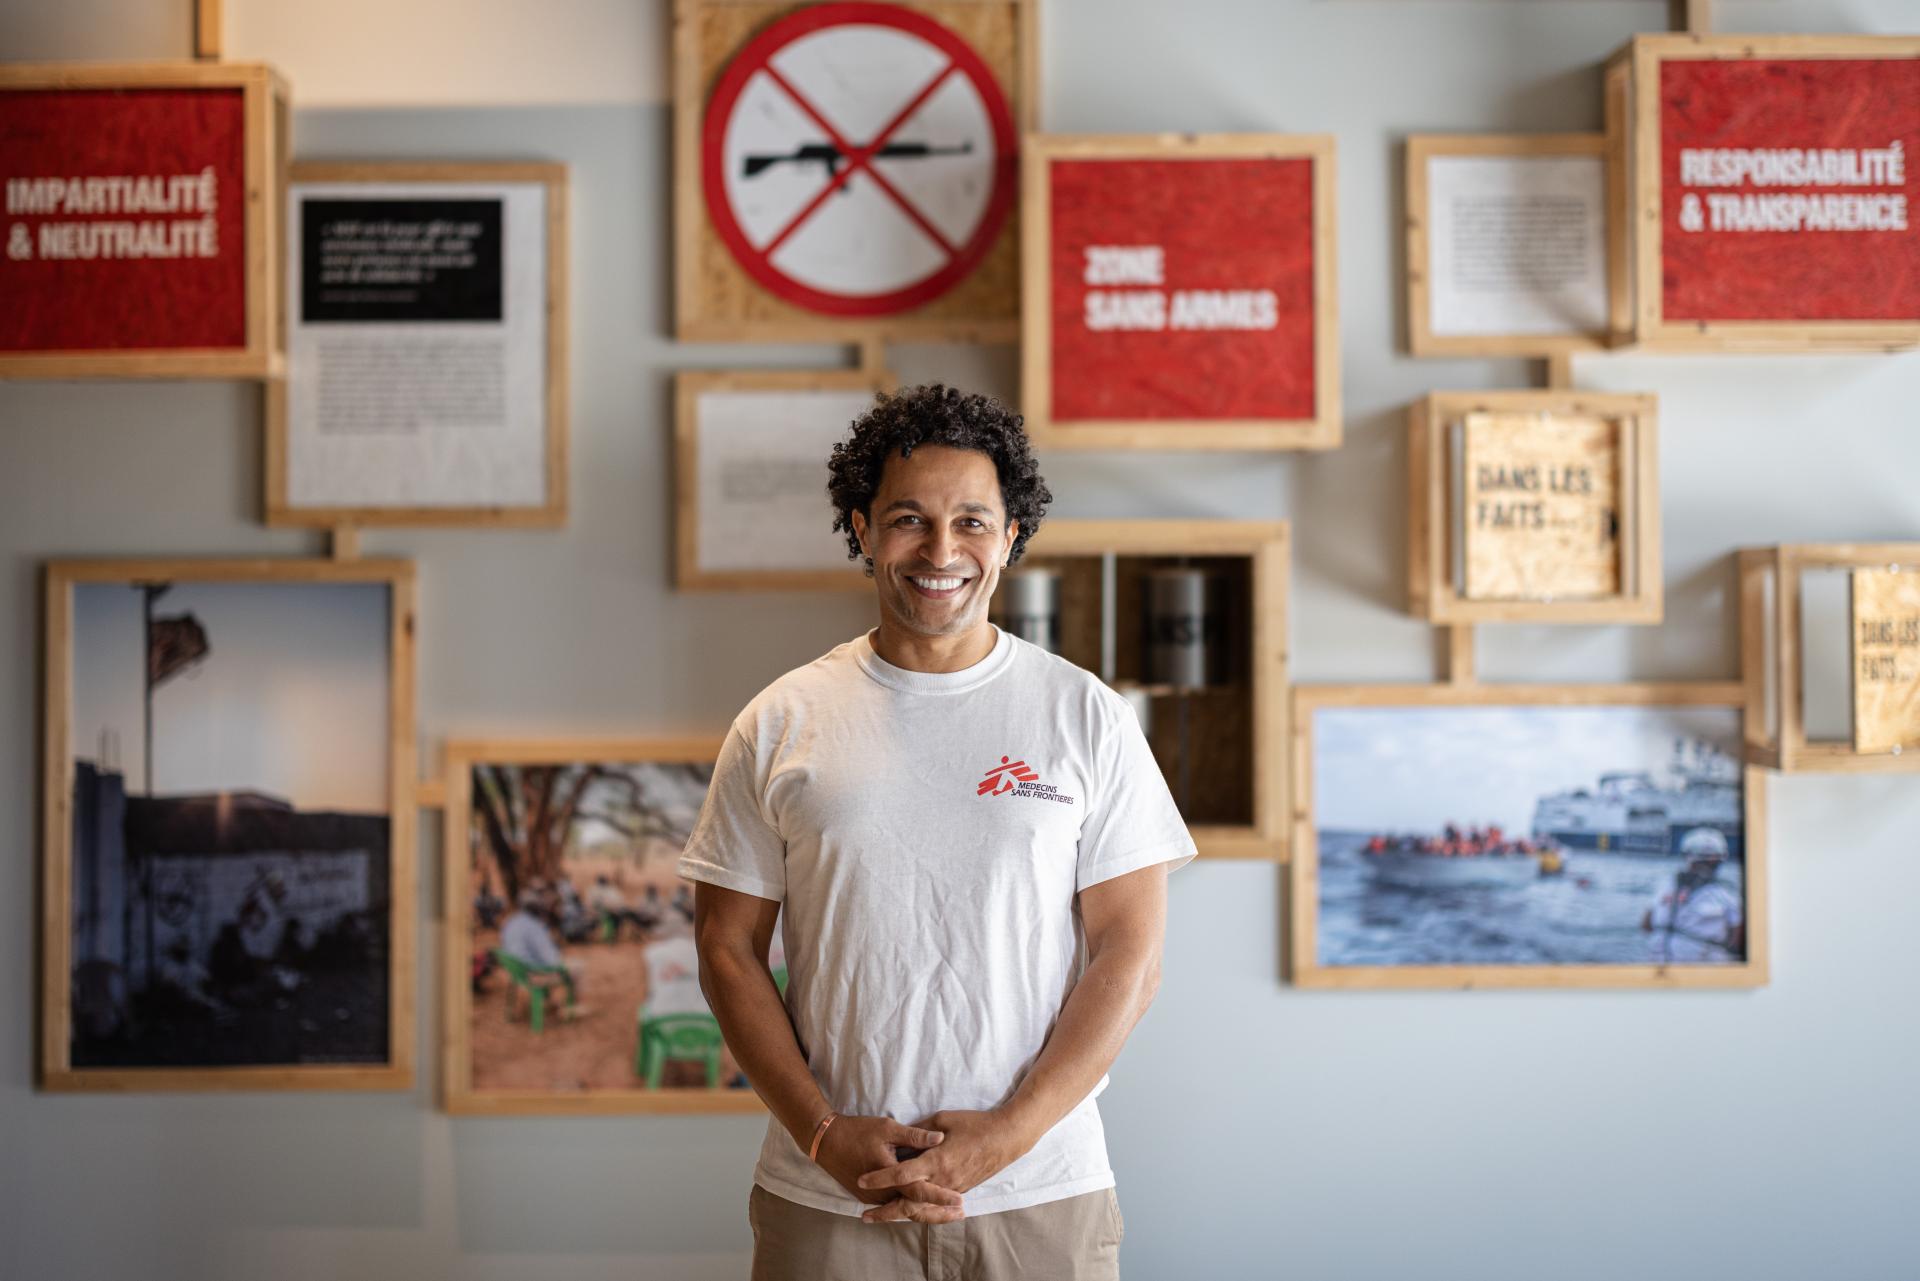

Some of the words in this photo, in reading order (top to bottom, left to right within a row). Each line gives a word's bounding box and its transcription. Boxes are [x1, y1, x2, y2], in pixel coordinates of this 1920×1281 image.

[1680, 140, 1905, 186] RESPONSABILITÉ
[6, 165, 217, 214] IMPARTIALITÉ
[1680, 193, 1704, 232] &
[1706, 193, 1908, 231] TRANSPARENCE
[7, 222, 33, 260] &
[38, 213, 219, 259] NEUTRALITÉ
[1084, 246, 1165, 286] ZONE
[1085, 290, 1167, 331] SANS
[1168, 290, 1279, 330] ARMES
[1478, 464, 1541, 492] DANS
[1550, 464, 1592, 495] LES
[1011, 789, 1031, 798] SANS
[1032, 791, 1074, 805] FRONTIERES
[1018, 782, 1058, 793] MEDECINS
